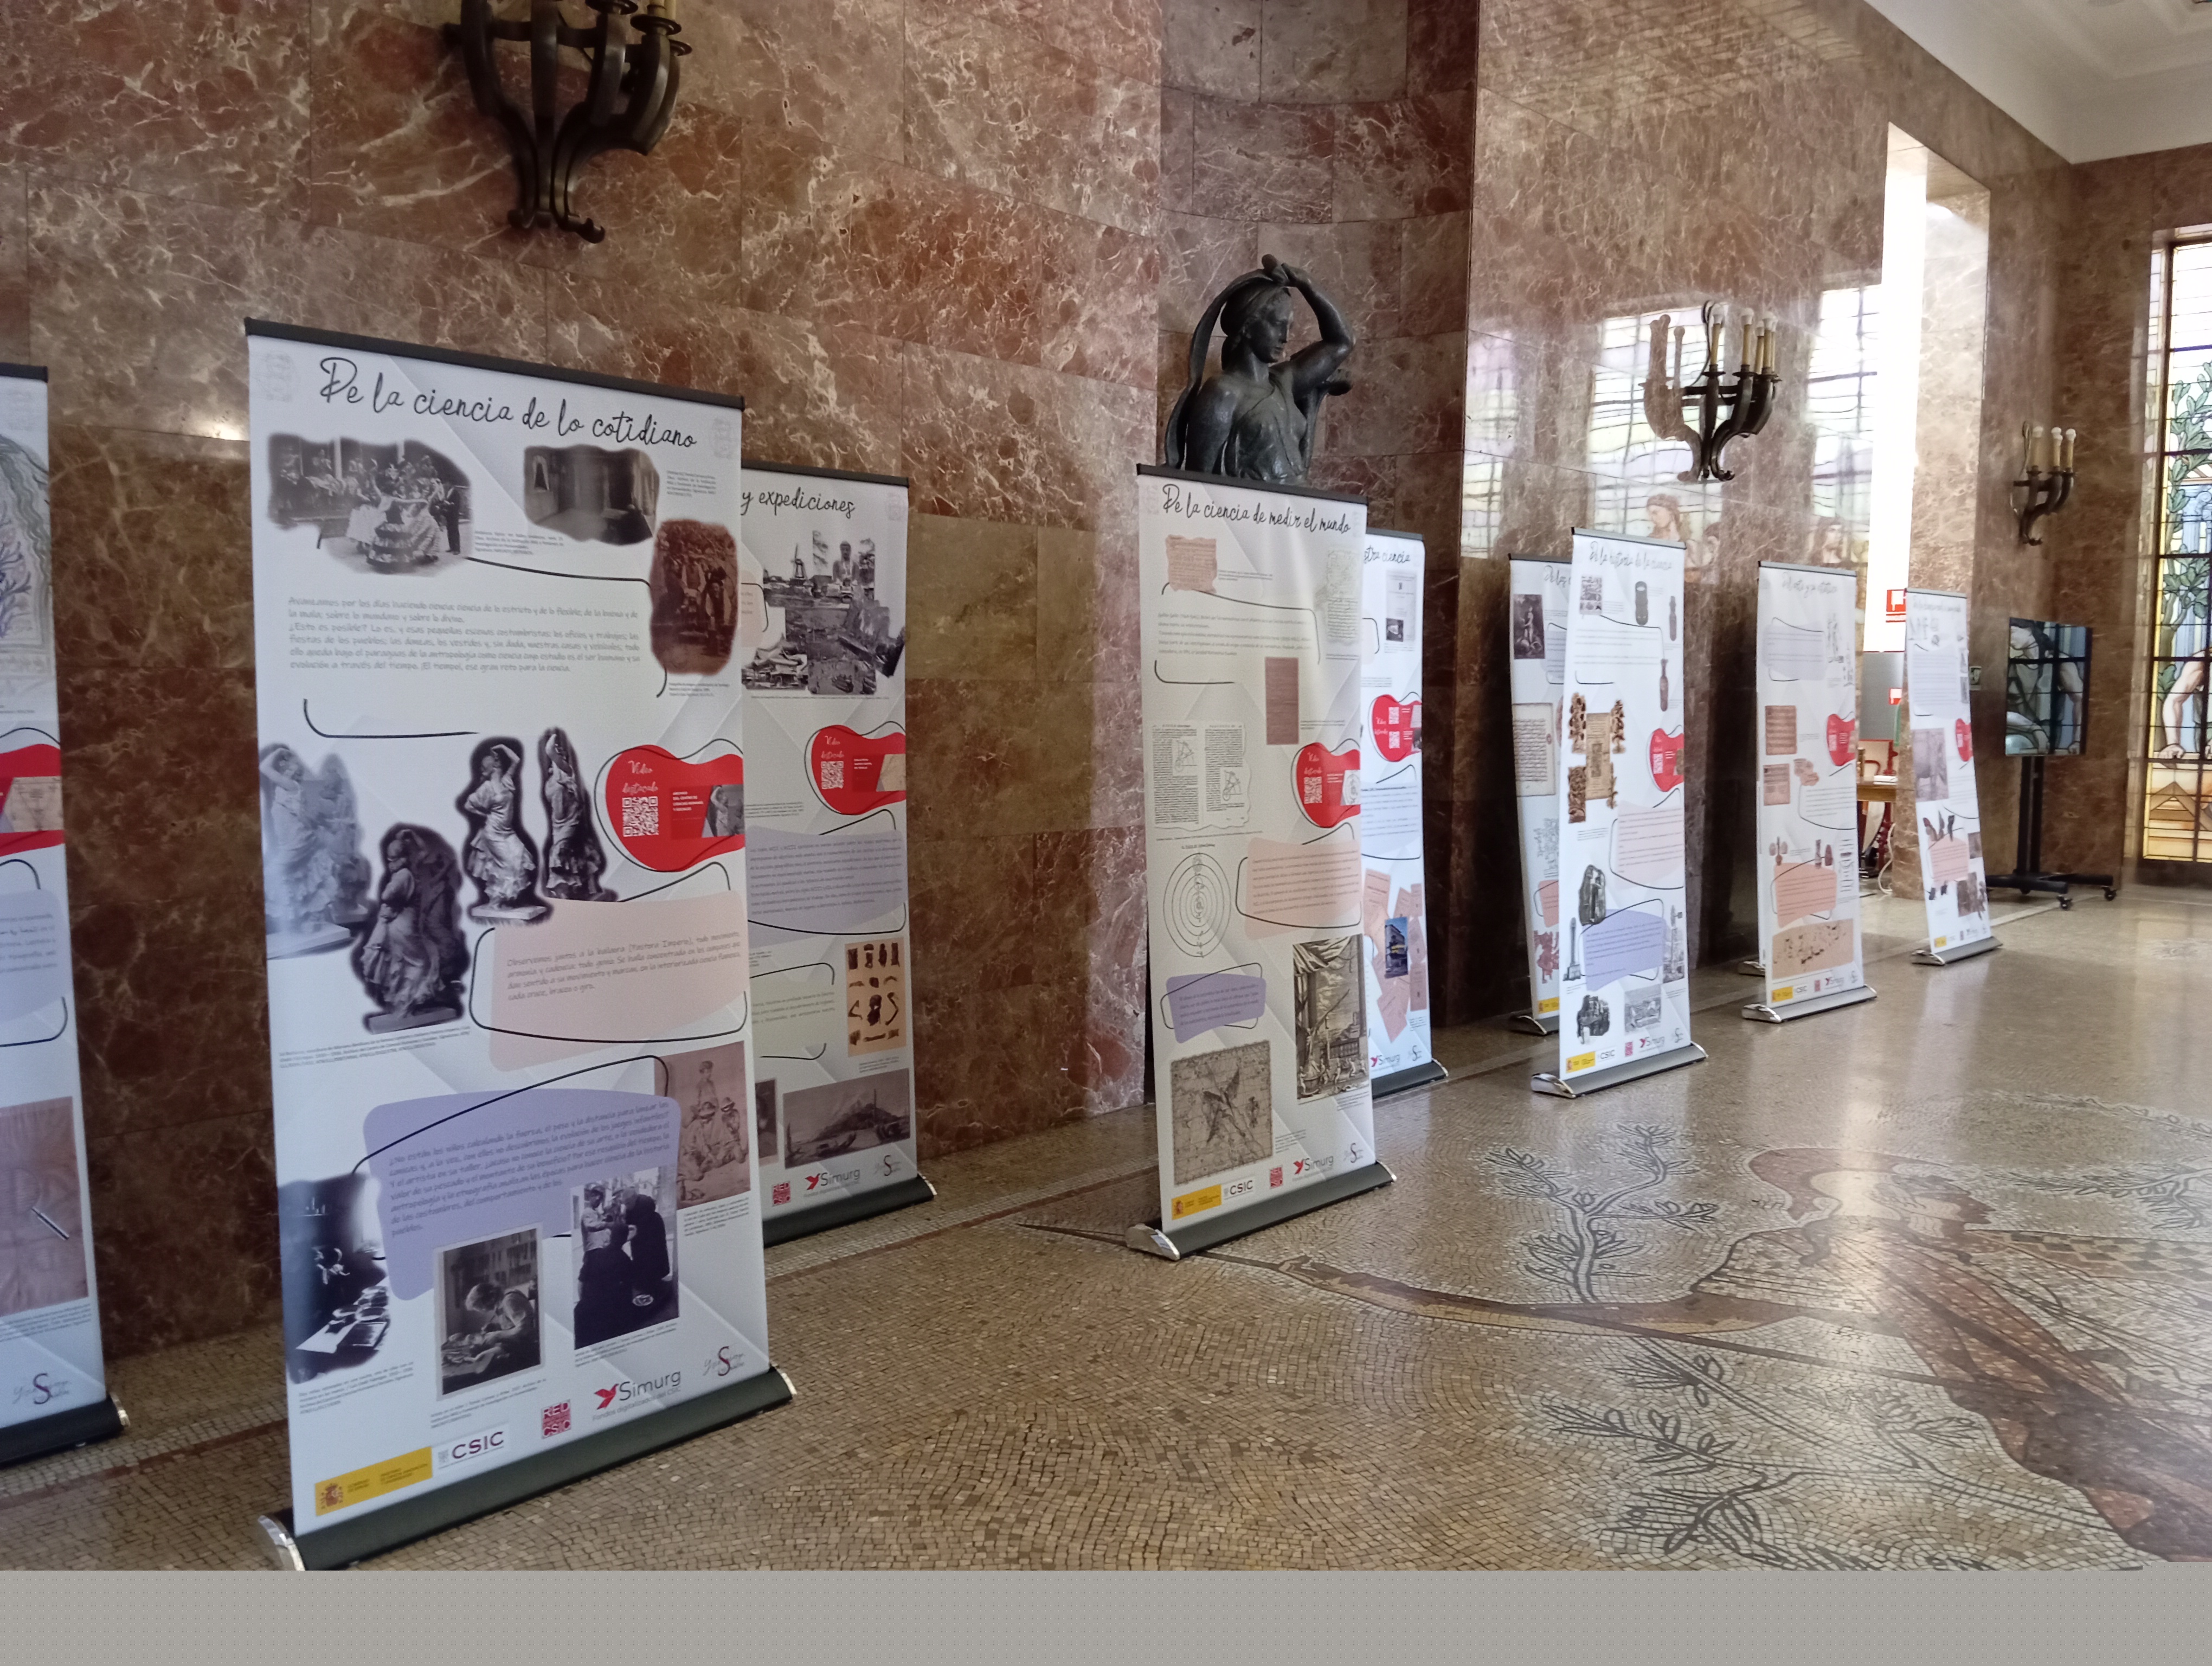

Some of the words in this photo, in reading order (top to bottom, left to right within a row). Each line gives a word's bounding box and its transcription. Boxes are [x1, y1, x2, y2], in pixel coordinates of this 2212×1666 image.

[320, 357, 363, 404] De
[372, 373, 404, 413] la
[414, 389, 513, 421] ciencia
[522, 397, 551, 430] de
[557, 399, 584, 437] lo
[593, 411, 697, 449] cotidiano
[759, 487, 855, 519] expediciones
[1162, 484, 1182, 513] De
[1186, 492, 1200, 518] la
[1204, 504, 1250, 523] ciencia
[1253, 503, 1268, 523] de
[1269, 507, 1301, 528] medir
[1304, 508, 1317, 532] el
[1320, 513, 1351, 534] mundo
[1364, 544, 1380, 564] stra
[1304, 1156, 1334, 1171] Simurg
[821, 1169, 860, 1186] Simurg
[1230, 1180, 1253, 1195] CSIC
[619, 1371, 681, 1401] Simurg
[544, 1402, 569, 1419] RED
[452, 1430, 505, 1459] CSIC
